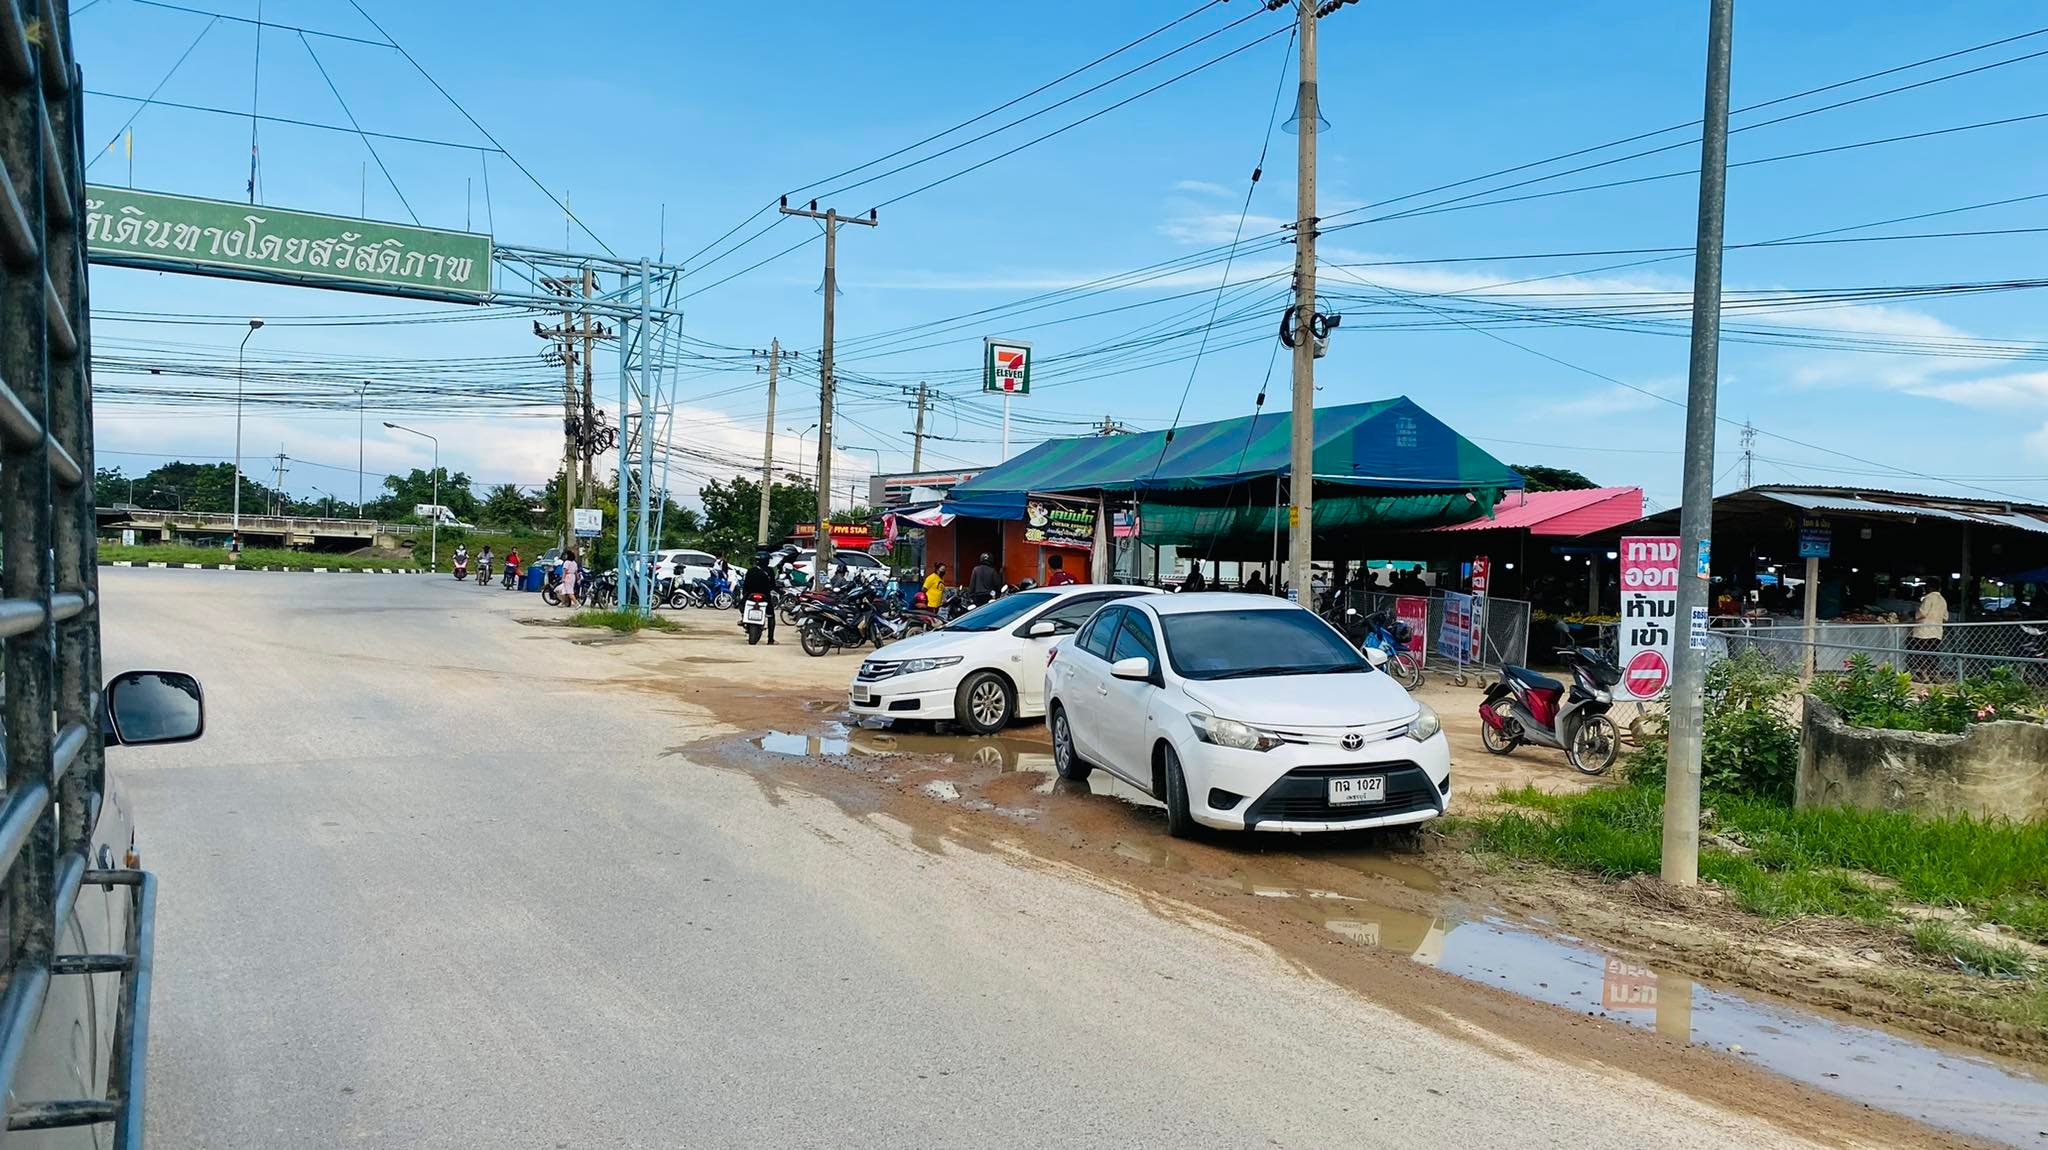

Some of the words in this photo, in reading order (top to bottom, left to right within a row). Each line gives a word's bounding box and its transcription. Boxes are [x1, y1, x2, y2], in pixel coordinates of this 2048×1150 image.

[834, 526, 849, 534] FIVE
[1628, 542, 1678, 562] ทาง
[1625, 567, 1679, 587] ออก
[1626, 593, 1676, 618] ห้าม
[1631, 622, 1669, 646] เข้า
[1357, 778, 1382, 791] 1027
